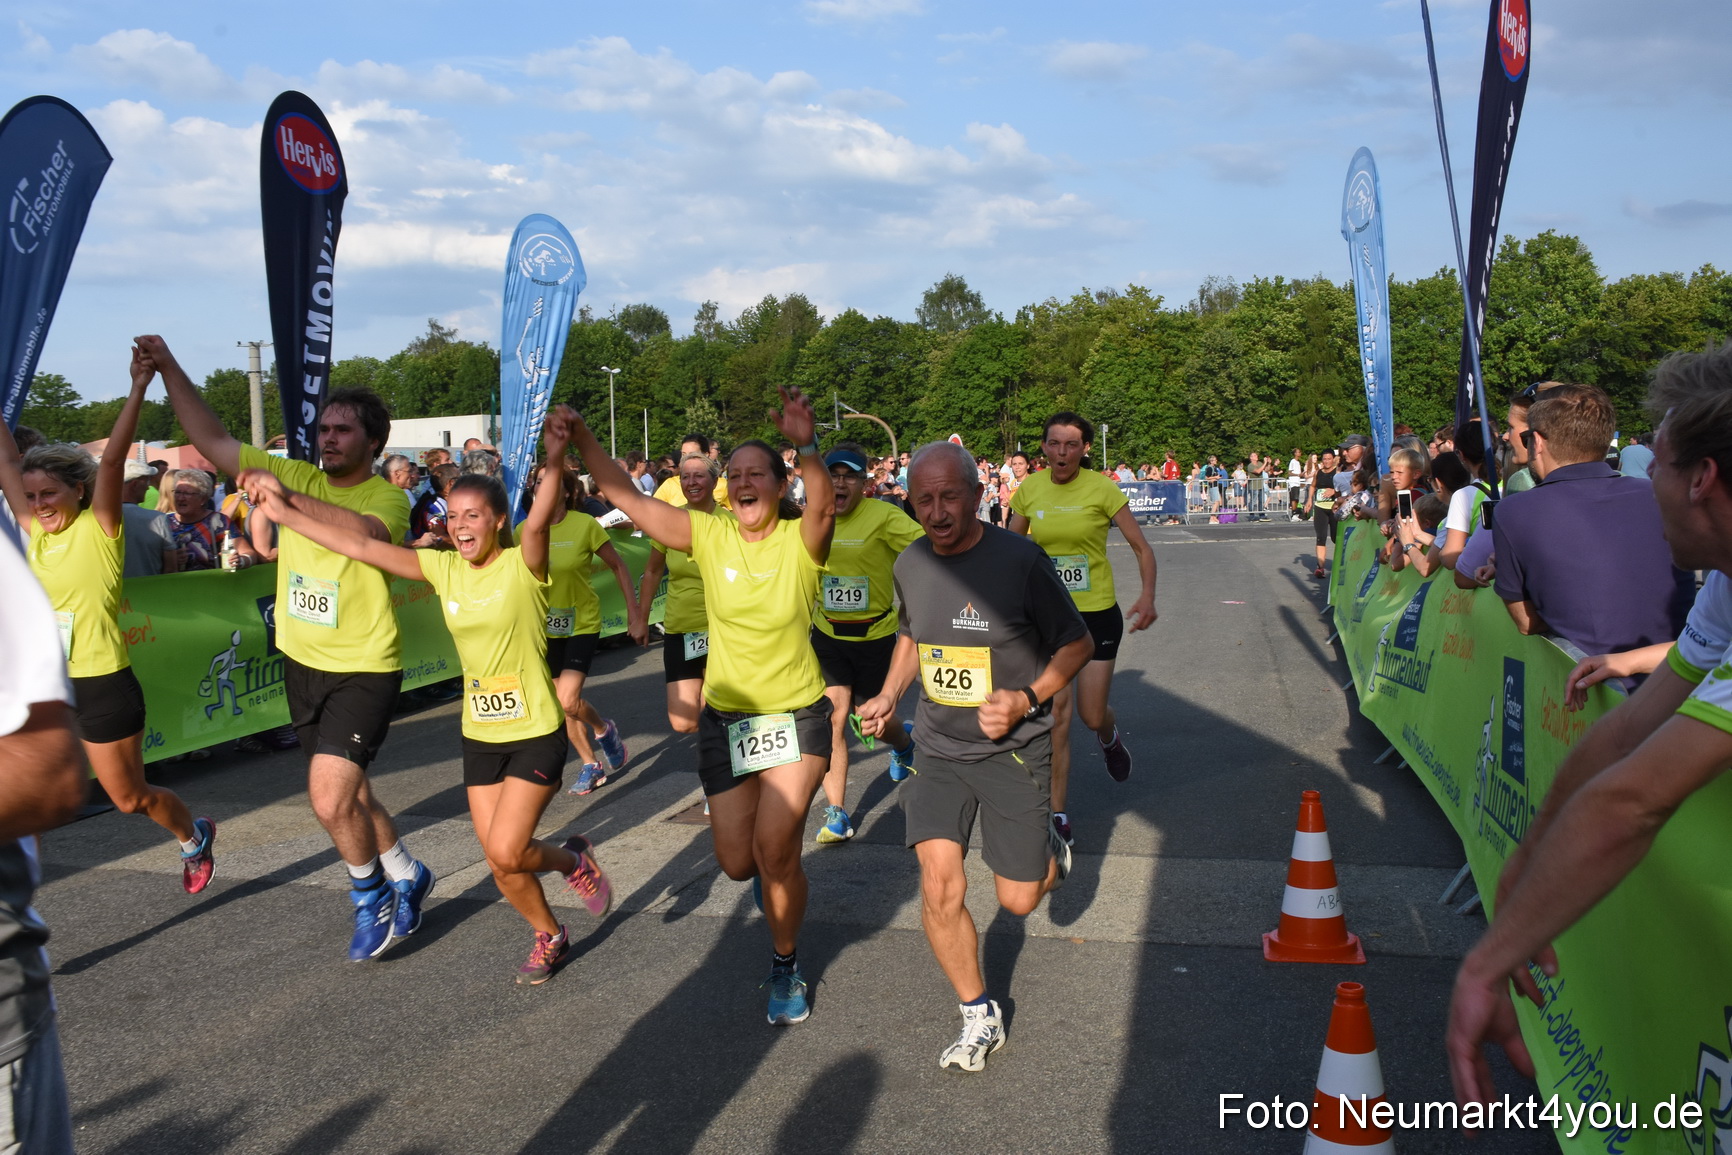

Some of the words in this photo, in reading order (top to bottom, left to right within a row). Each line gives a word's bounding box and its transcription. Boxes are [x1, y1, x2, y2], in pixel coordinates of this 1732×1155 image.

[1500, 0, 1527, 59] Hervis
[280, 124, 336, 178] Hervis
[22, 138, 68, 237] Fischer
[41, 158, 75, 237] AUTOMOBILE
[1128, 495, 1167, 507] scher
[292, 589, 329, 613] 1308
[828, 588, 862, 602] 1219
[952, 618, 989, 628] BURKHARDT
[1382, 639, 1434, 693] firmenlauf
[933, 667, 972, 690] 426
[472, 691, 517, 713] 1305
[935, 688, 954, 696] Schardt
[1506, 692, 1522, 719] Fischer
[737, 729, 788, 759] 1255
[747, 755, 761, 763] Lang
[760, 751, 781, 760] Andrea
